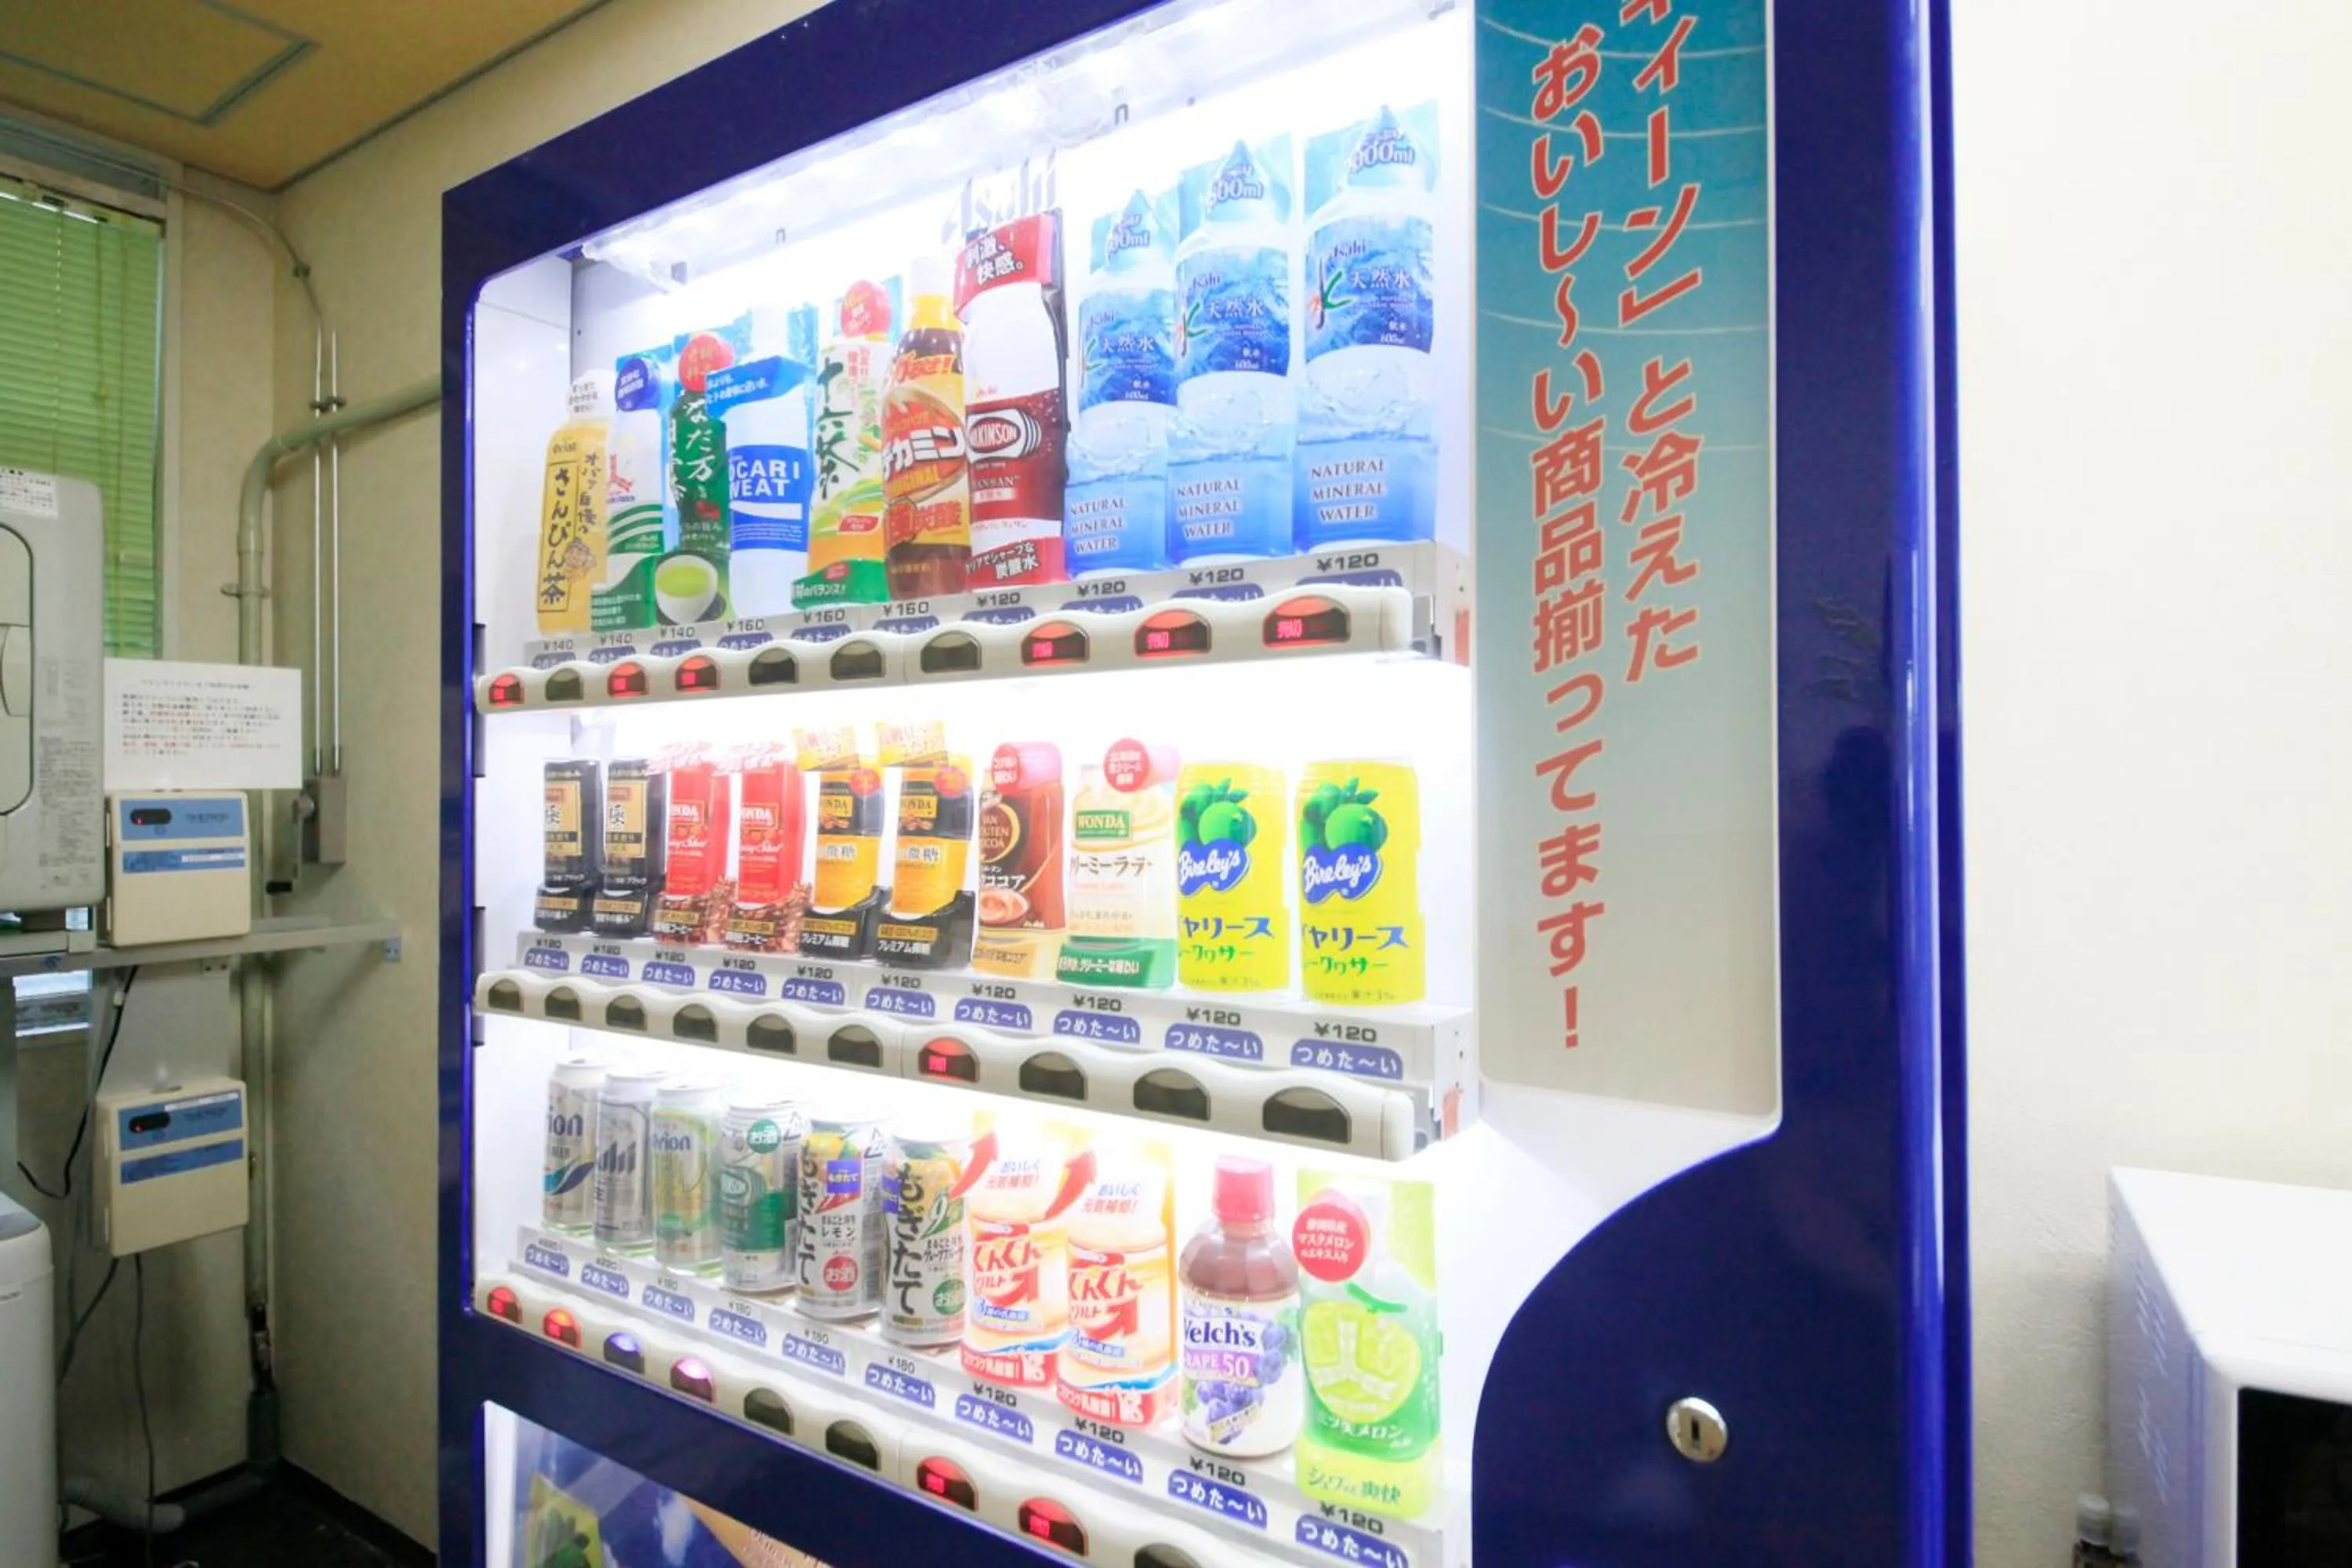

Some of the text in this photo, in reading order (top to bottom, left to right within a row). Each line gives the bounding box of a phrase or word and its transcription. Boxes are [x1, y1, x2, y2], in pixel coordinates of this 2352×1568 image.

[1352, 267, 1411, 290] 天然水
[1210, 299, 1265, 320] 天然水
[882, 426, 967, 484] デカミン
[729, 460, 800, 480] OCARI
[1311, 459, 1385, 478] NATURAL
[730, 478, 791, 497] WEAT
[1178, 479, 1240, 498] NATURAL
[1313, 481, 1385, 501] MINERAL
[1319, 506, 1375, 522] WATER
[540, 467, 570, 604] さんぴん茶
[1184, 521, 1231, 538] WATER
[1317, 553, 1378, 572] ¥120
[1190, 568, 1244, 585] ¥120
[1077, 581, 1126, 597] ¥120
[978, 592, 1021, 607] ¥120
[1078, 815, 1126, 829] WONDA
[1071, 855, 1153, 877] リーミーラテ
[1178, 915, 1274, 940] ヤリース
[1301, 922, 1409, 951] ヤリース
[798, 966, 833, 979] ¥120
[881, 974, 921, 989] ¥120
[971, 984, 1016, 1000] ¥120
[1073, 994, 1122, 1011] ¥120
[1186, 1007, 1241, 1026] ¥120
[1315, 1022, 1377, 1043] ¥120
[893, 1163, 924, 1316] もぎたて
[1185, 1350, 1250, 1380] RAPE 50
[973, 1381, 1018, 1407] ¥120
[1075, 1417, 1126, 1445] ¥120
[1189, 1455, 1247, 1487] ¥120
[1319, 1501, 1385, 1535] ¥120
